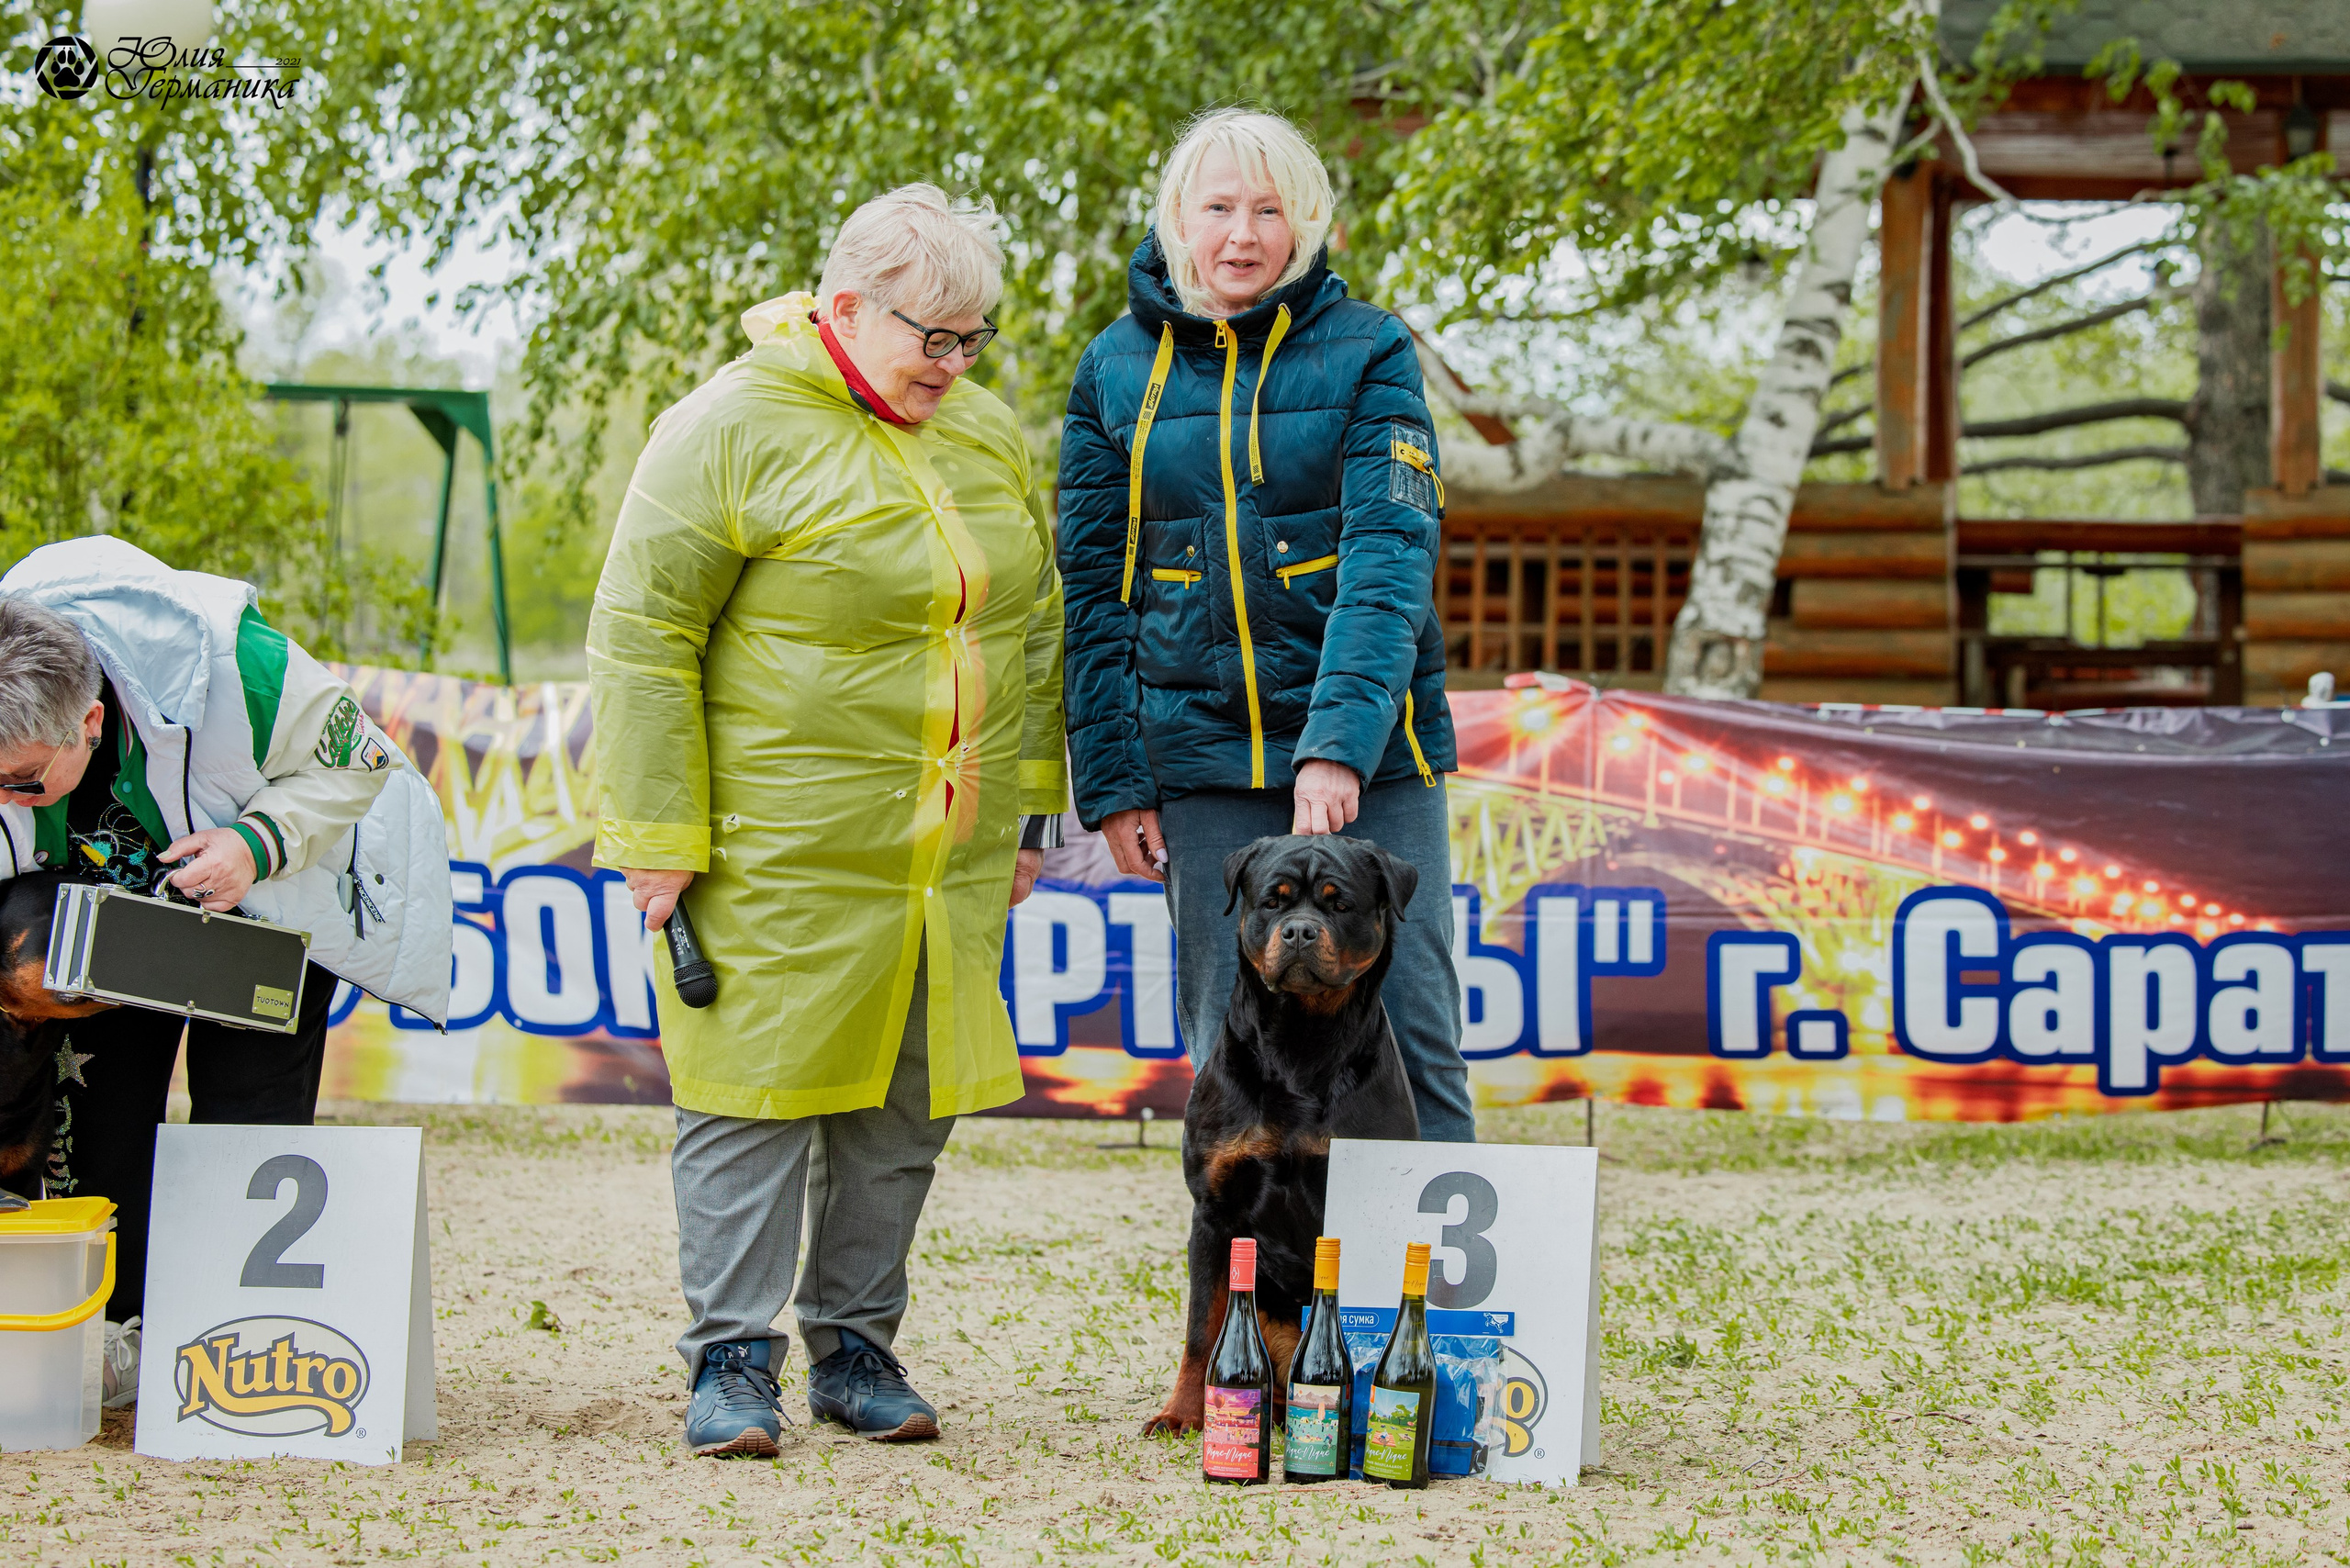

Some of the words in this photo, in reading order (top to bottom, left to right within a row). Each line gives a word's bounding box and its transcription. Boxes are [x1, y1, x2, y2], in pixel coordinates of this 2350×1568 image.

[257, 996, 289, 1008] TUOTOWN
[1713, 935, 1844, 1056] г.
[240, 1154, 328, 1288] 2
[1417, 1171, 1499, 1309] 3
[1349, 1315, 1374, 1327] сумка
[178, 1333, 360, 1430] Nutro
